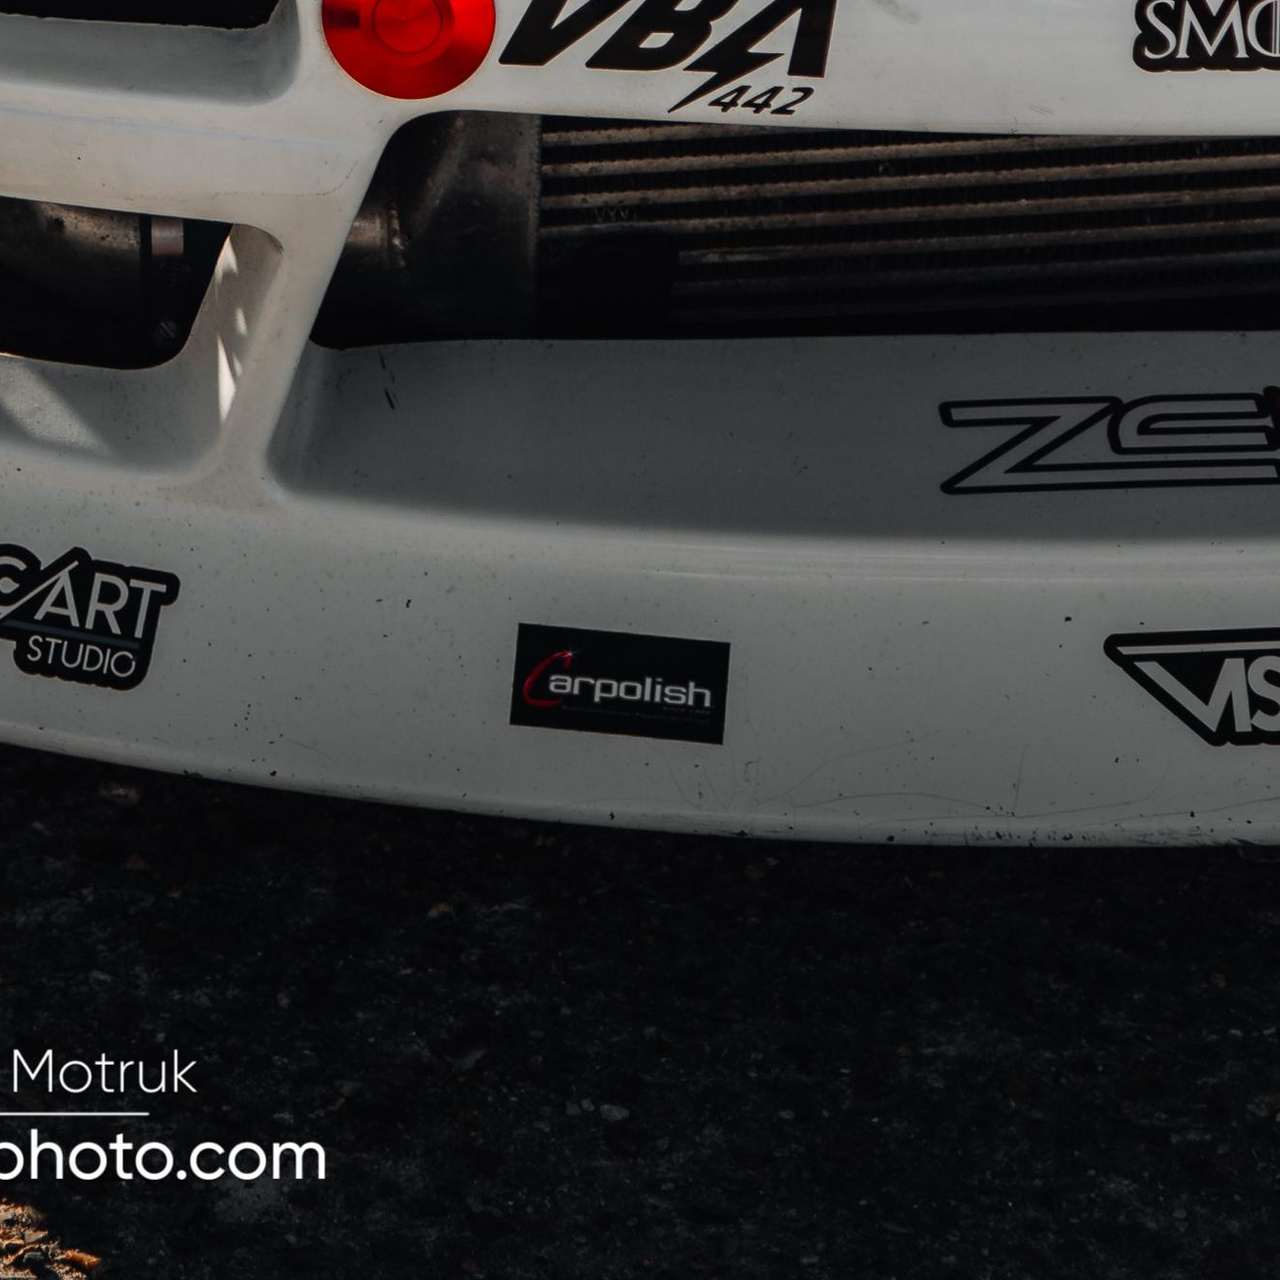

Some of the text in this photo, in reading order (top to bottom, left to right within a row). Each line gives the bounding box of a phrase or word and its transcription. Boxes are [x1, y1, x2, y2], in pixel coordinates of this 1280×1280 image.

[708, 85, 815, 116] 442
[26, 635, 136, 678] STUDIO
[523, 650, 713, 708] Carpolish
